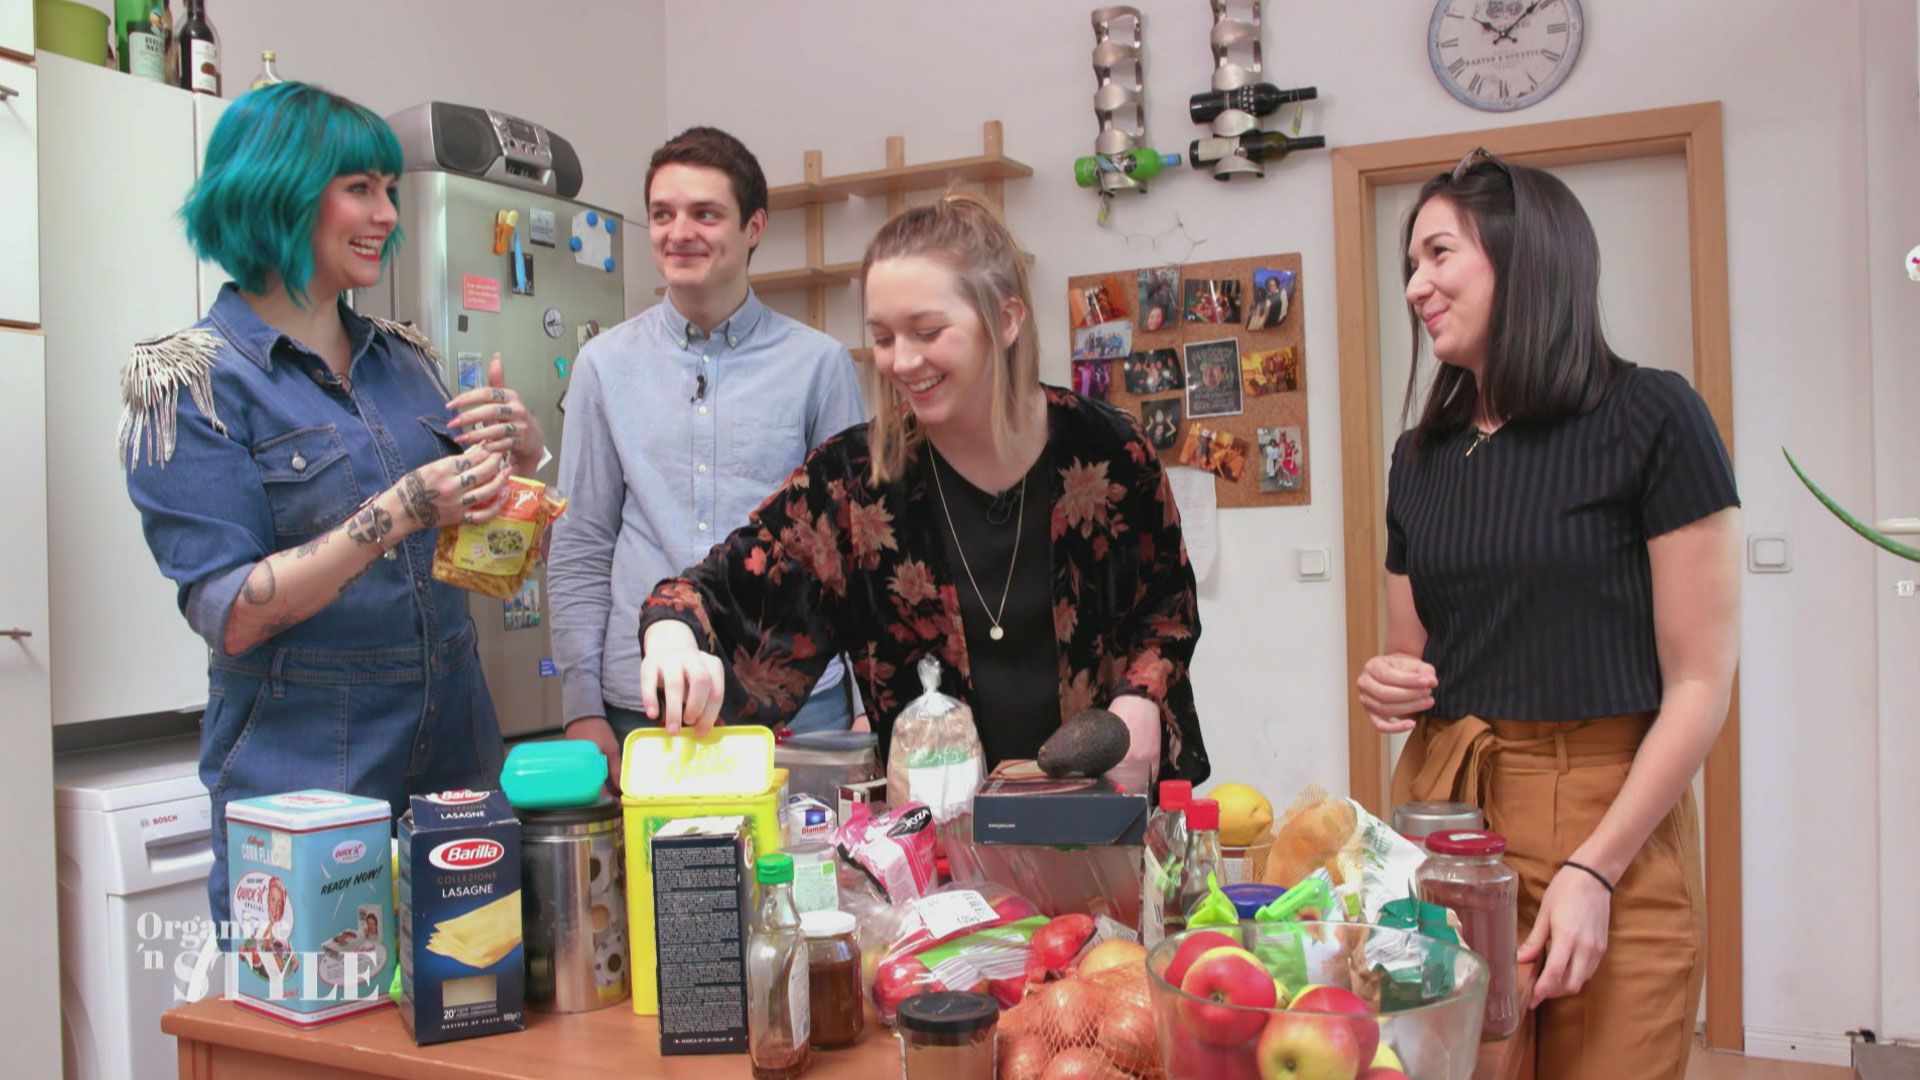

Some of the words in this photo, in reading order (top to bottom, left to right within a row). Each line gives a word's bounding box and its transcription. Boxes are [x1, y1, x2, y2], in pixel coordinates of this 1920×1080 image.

[153, 814, 178, 825] BOSCH
[441, 811, 486, 820] LASAGNE
[801, 823, 829, 835] Diamant
[447, 844, 498, 861] Barilla
[320, 875, 353, 896] READY
[353, 864, 384, 885] NOW!
[437, 873, 497, 885] COLLEZIONE
[442, 884, 494, 898] LASAGNE
[441, 1021, 468, 1030] MASTERS
